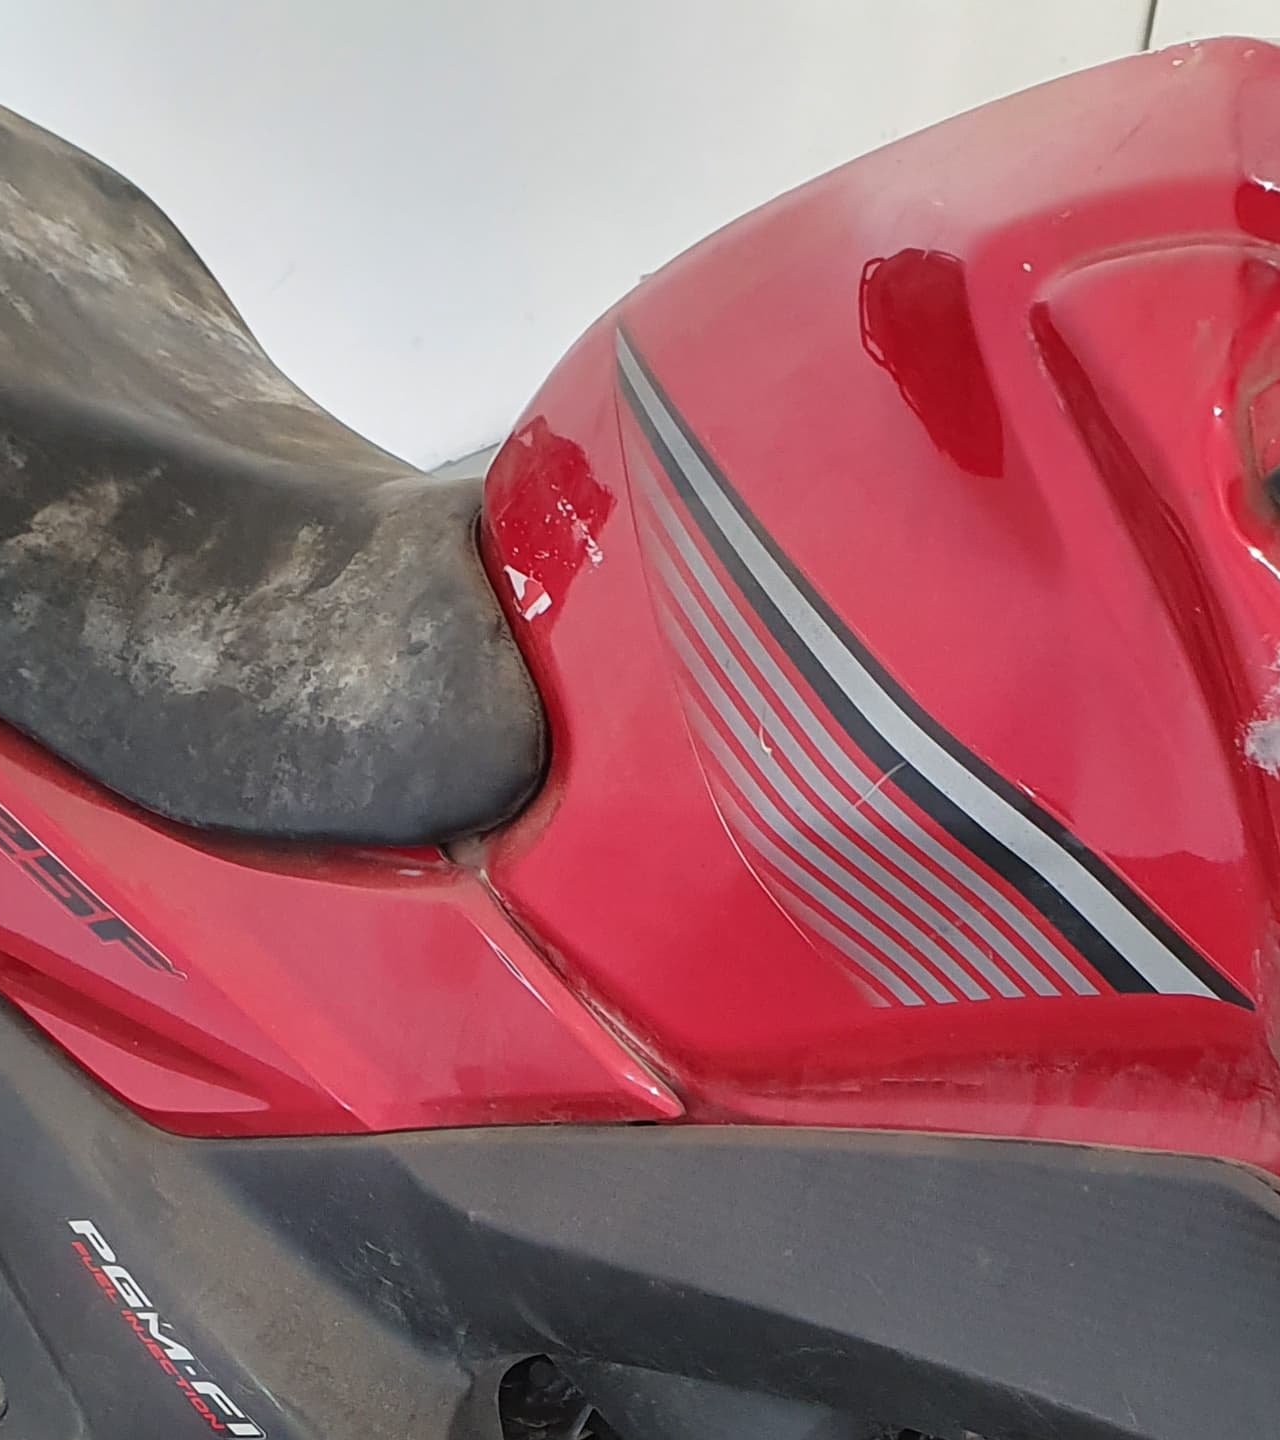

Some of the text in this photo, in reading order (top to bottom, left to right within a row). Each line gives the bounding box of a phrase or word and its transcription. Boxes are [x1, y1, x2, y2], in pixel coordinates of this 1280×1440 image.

[68, 1219, 262, 1436] PGM-FI
[71, 1240, 225, 1431] FUEL INJECTION
